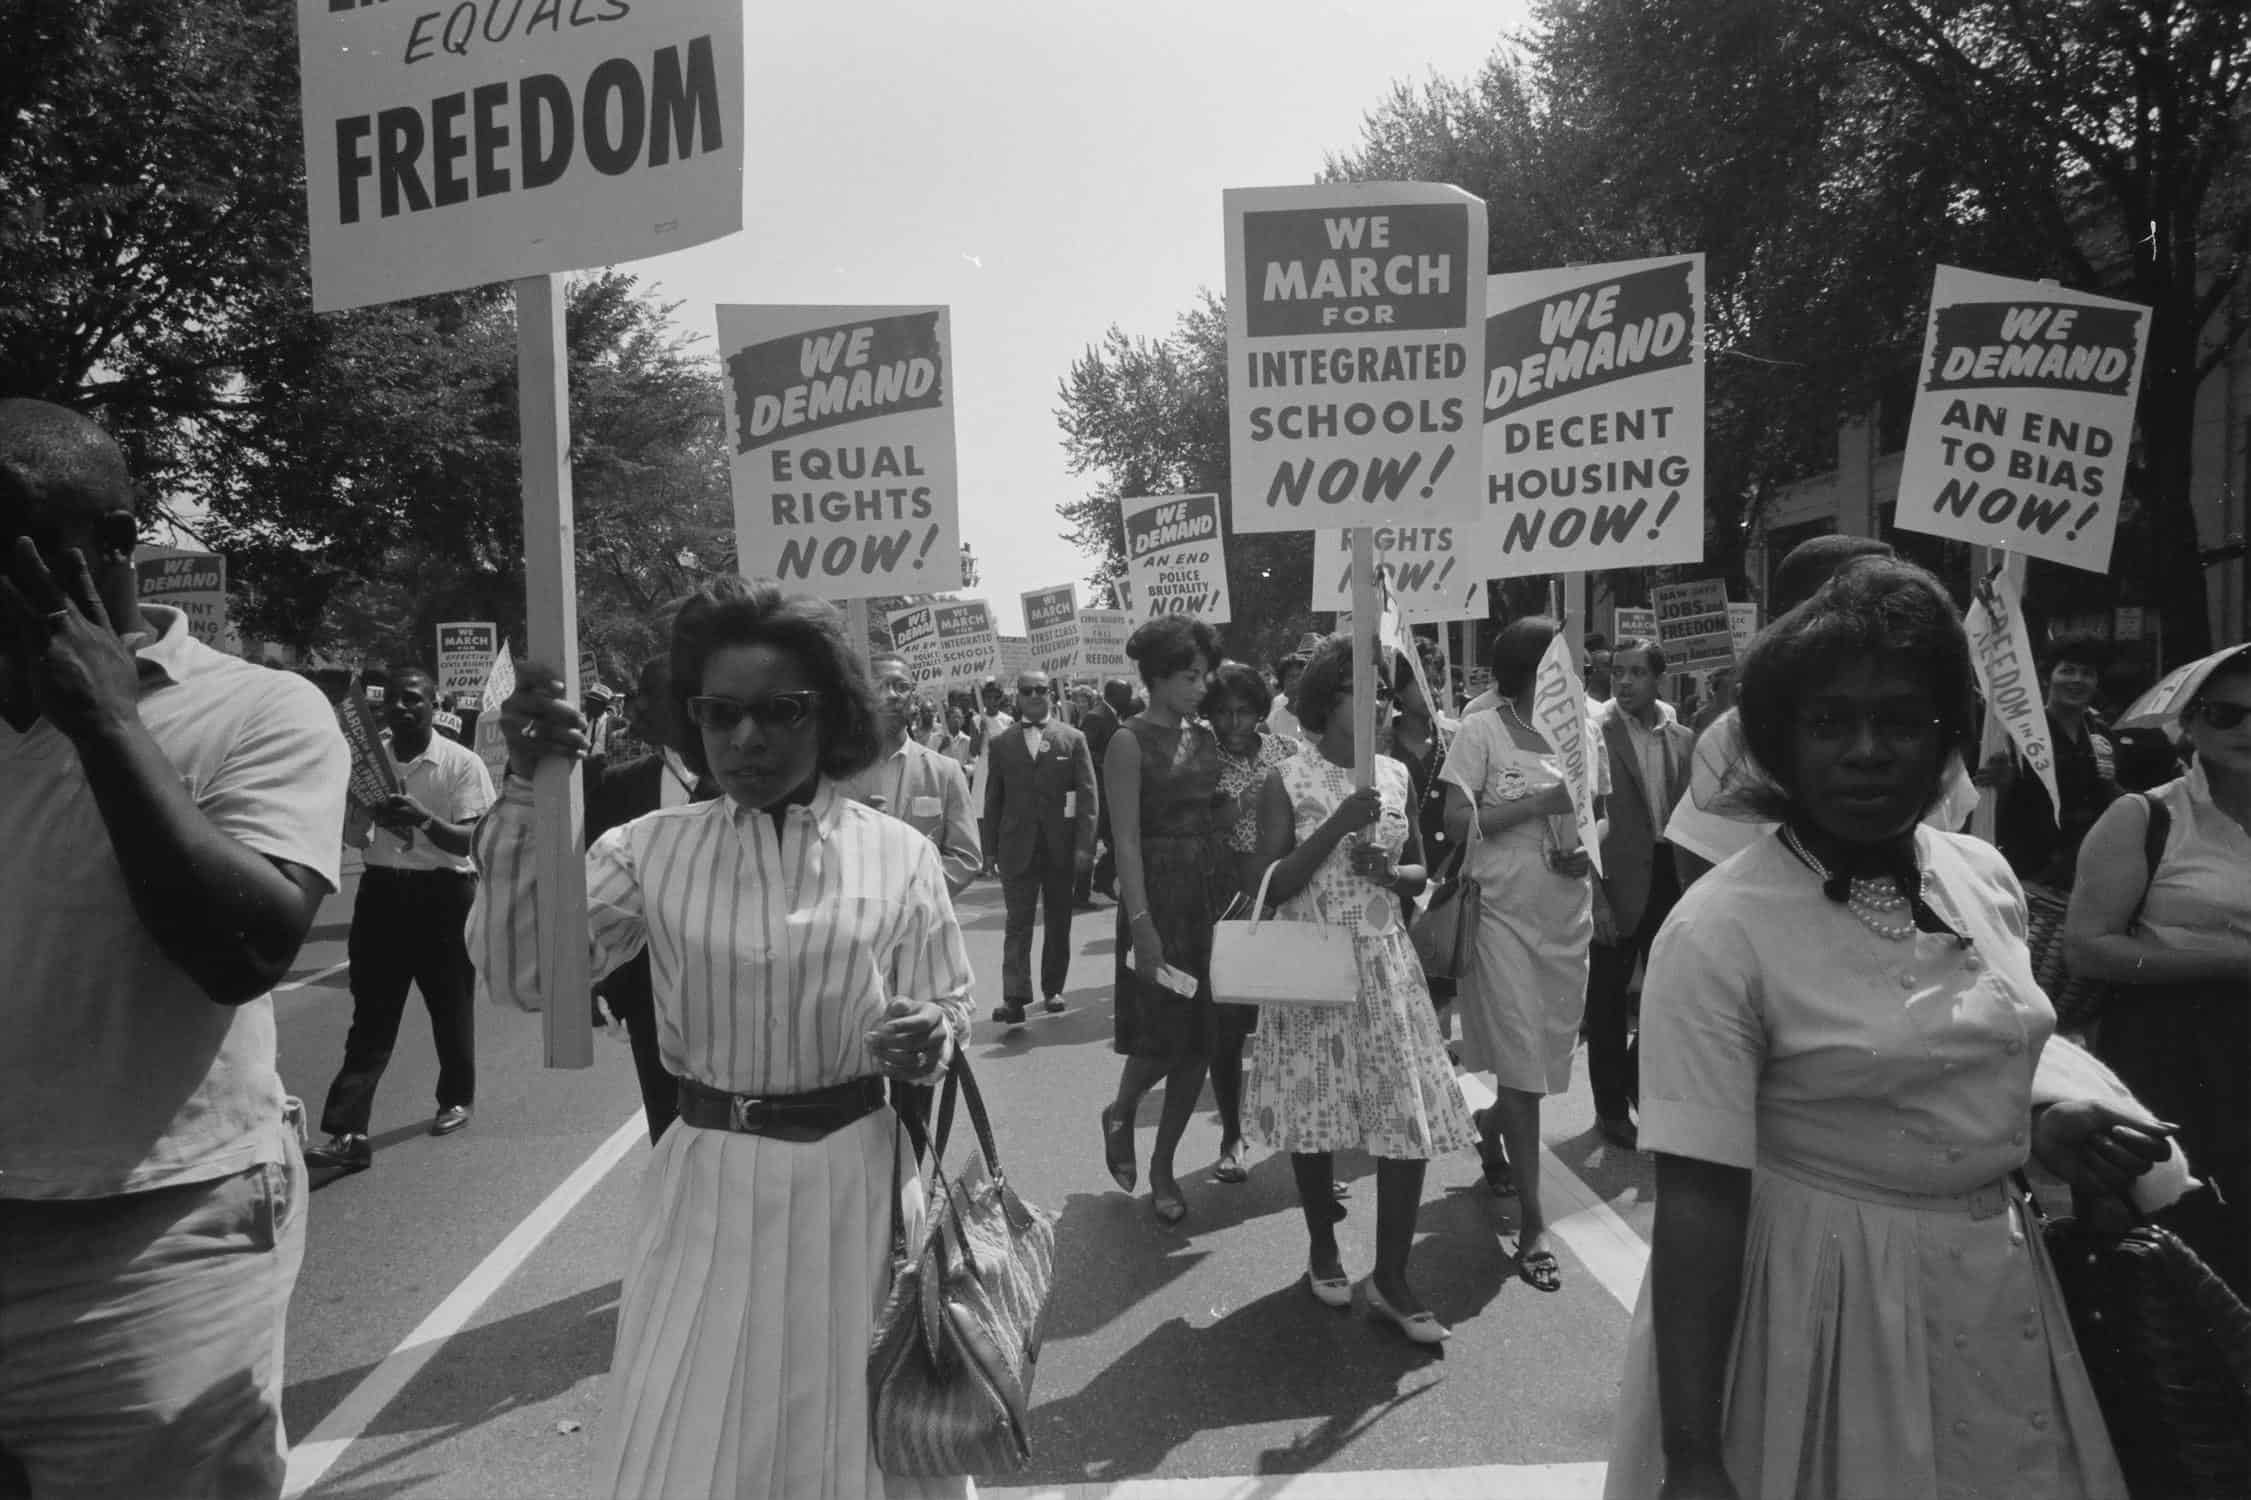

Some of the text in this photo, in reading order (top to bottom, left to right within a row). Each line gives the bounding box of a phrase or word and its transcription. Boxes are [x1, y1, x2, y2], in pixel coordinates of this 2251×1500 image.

[404, 0, 630, 64] EQUALS
[336, 34, 723, 224] FREEDOM
[1324, 216, 1390, 249] WE
[1263, 254, 1450, 301] MARCH
[1322, 304, 1395, 326] FOR
[1540, 285, 1620, 345] WE
[2000, 307, 2078, 341] WE
[800, 327, 874, 378] WE
[1248, 343, 1466, 388] INTEGRATED
[1485, 312, 1686, 410] DEMAND
[1942, 344, 2127, 382] DEMAND
[750, 357, 935, 437] DEMAND
[1250, 398, 1463, 442] SCHOOLS
[1505, 406, 1673, 454] DECENT
[1940, 399, 2112, 458] AN END
[771, 445, 925, 482] EQUAL
[1266, 444, 1455, 507] NOW!
[1489, 456, 1690, 504] HOUSING
[1941, 436, 2104, 496] TO BIAS
[771, 487, 931, 525] RIGHTS
[1156, 502, 1188, 526] WE
[1502, 490, 1680, 553] NOW!
[1933, 478, 2099, 541] NOW!
[776, 523, 939, 580] NOW!
[1136, 515, 1213, 554] DEMAND
[164, 559, 195, 574] WE
[1144, 552, 1210, 567] AN END
[1160, 570, 1200, 583] POLICE
[143, 572, 218, 593] DEMAND
[1148, 582, 1208, 596] BRUTALITY
[908, 610, 928, 627] WE
[941, 613, 985, 630] MARCH
[1032, 602, 1071, 619] MARCH
[1149, 589, 1220, 617] NOW!
[444, 636, 488, 645] MARCH
[943, 632, 992, 649] INTEGRATED
[943, 644, 995, 662] SCHOOLS
[1535, 661, 1583, 783] FREEDOM
